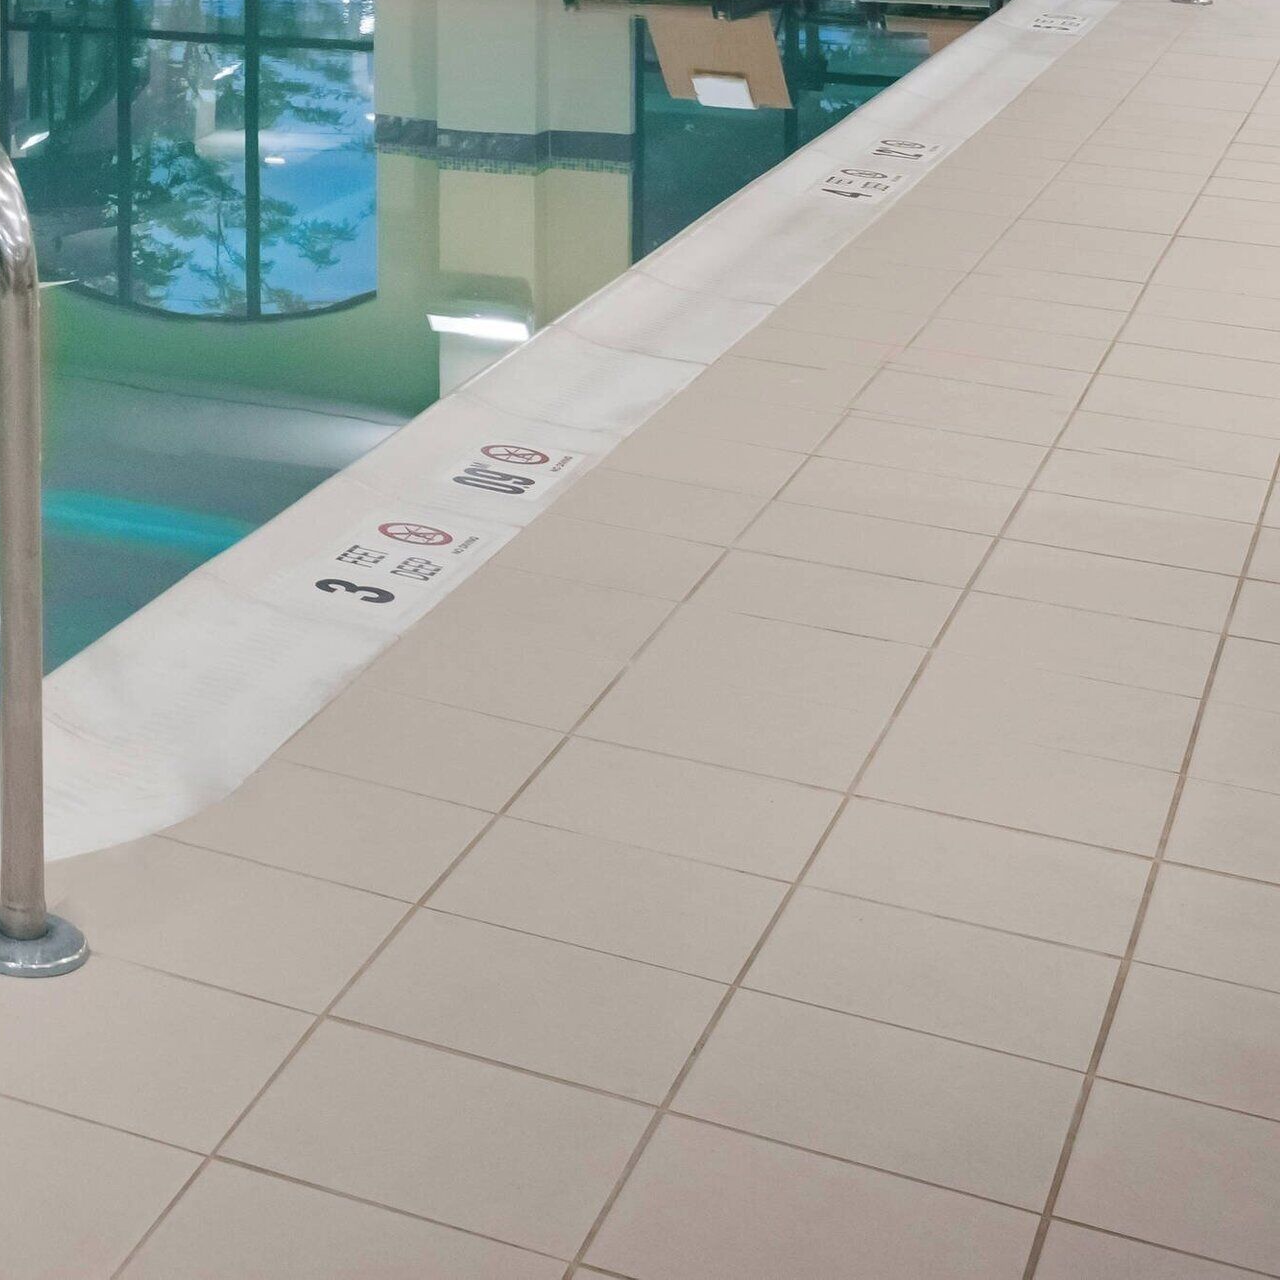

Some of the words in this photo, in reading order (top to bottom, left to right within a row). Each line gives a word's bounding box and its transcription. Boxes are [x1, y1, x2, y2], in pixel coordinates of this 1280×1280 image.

[336, 544, 389, 568] FEET
[390, 556, 443, 582] DEEP
[314, 578, 395, 604] 3
